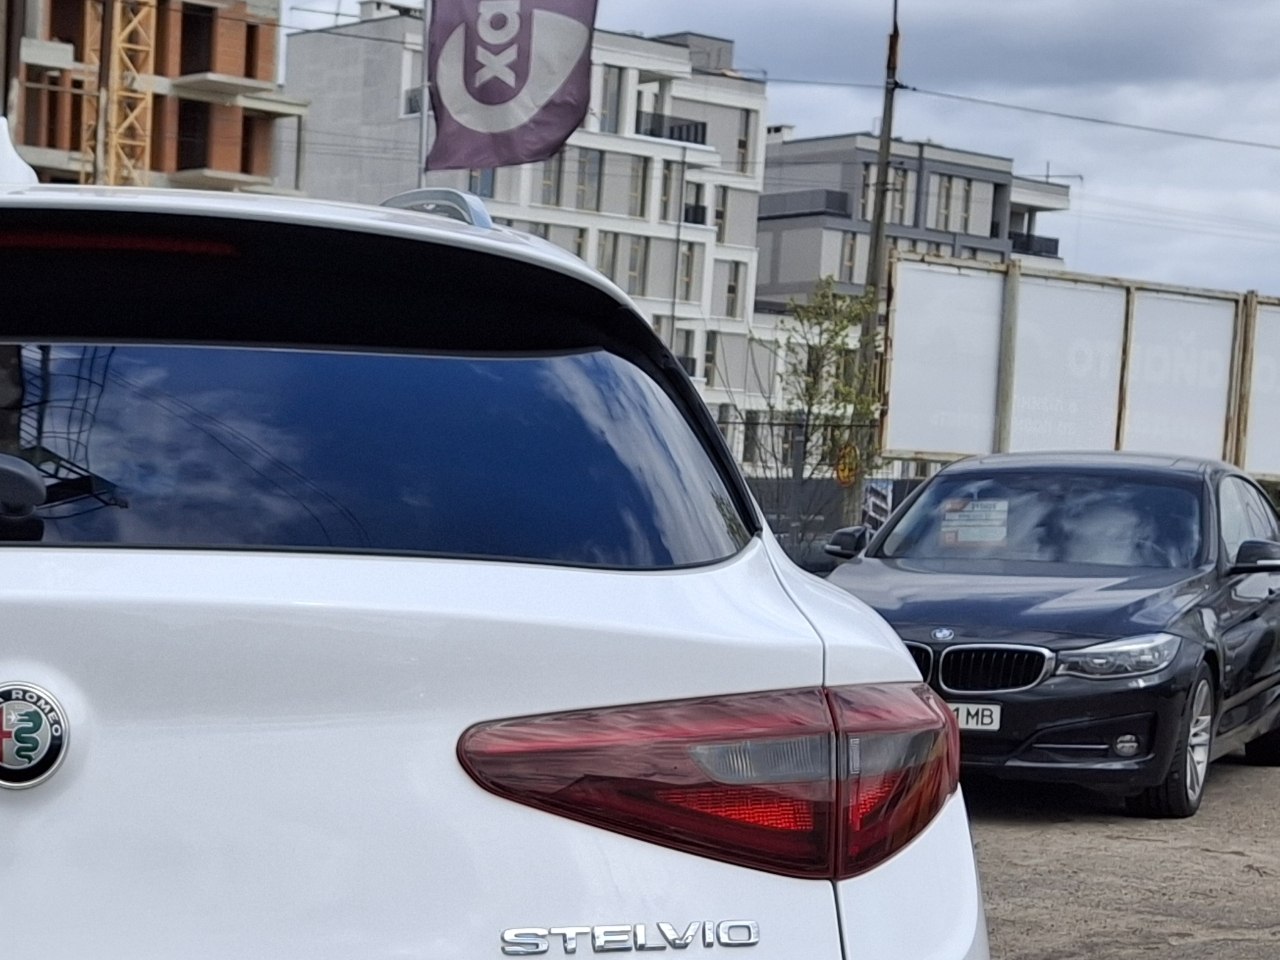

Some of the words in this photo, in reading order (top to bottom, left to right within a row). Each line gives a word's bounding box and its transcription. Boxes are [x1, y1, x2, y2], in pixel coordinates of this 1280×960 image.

[11, 689, 62, 737] ROMEO
[965, 707, 995, 726] MB
[501, 920, 760, 955] STELVIO
